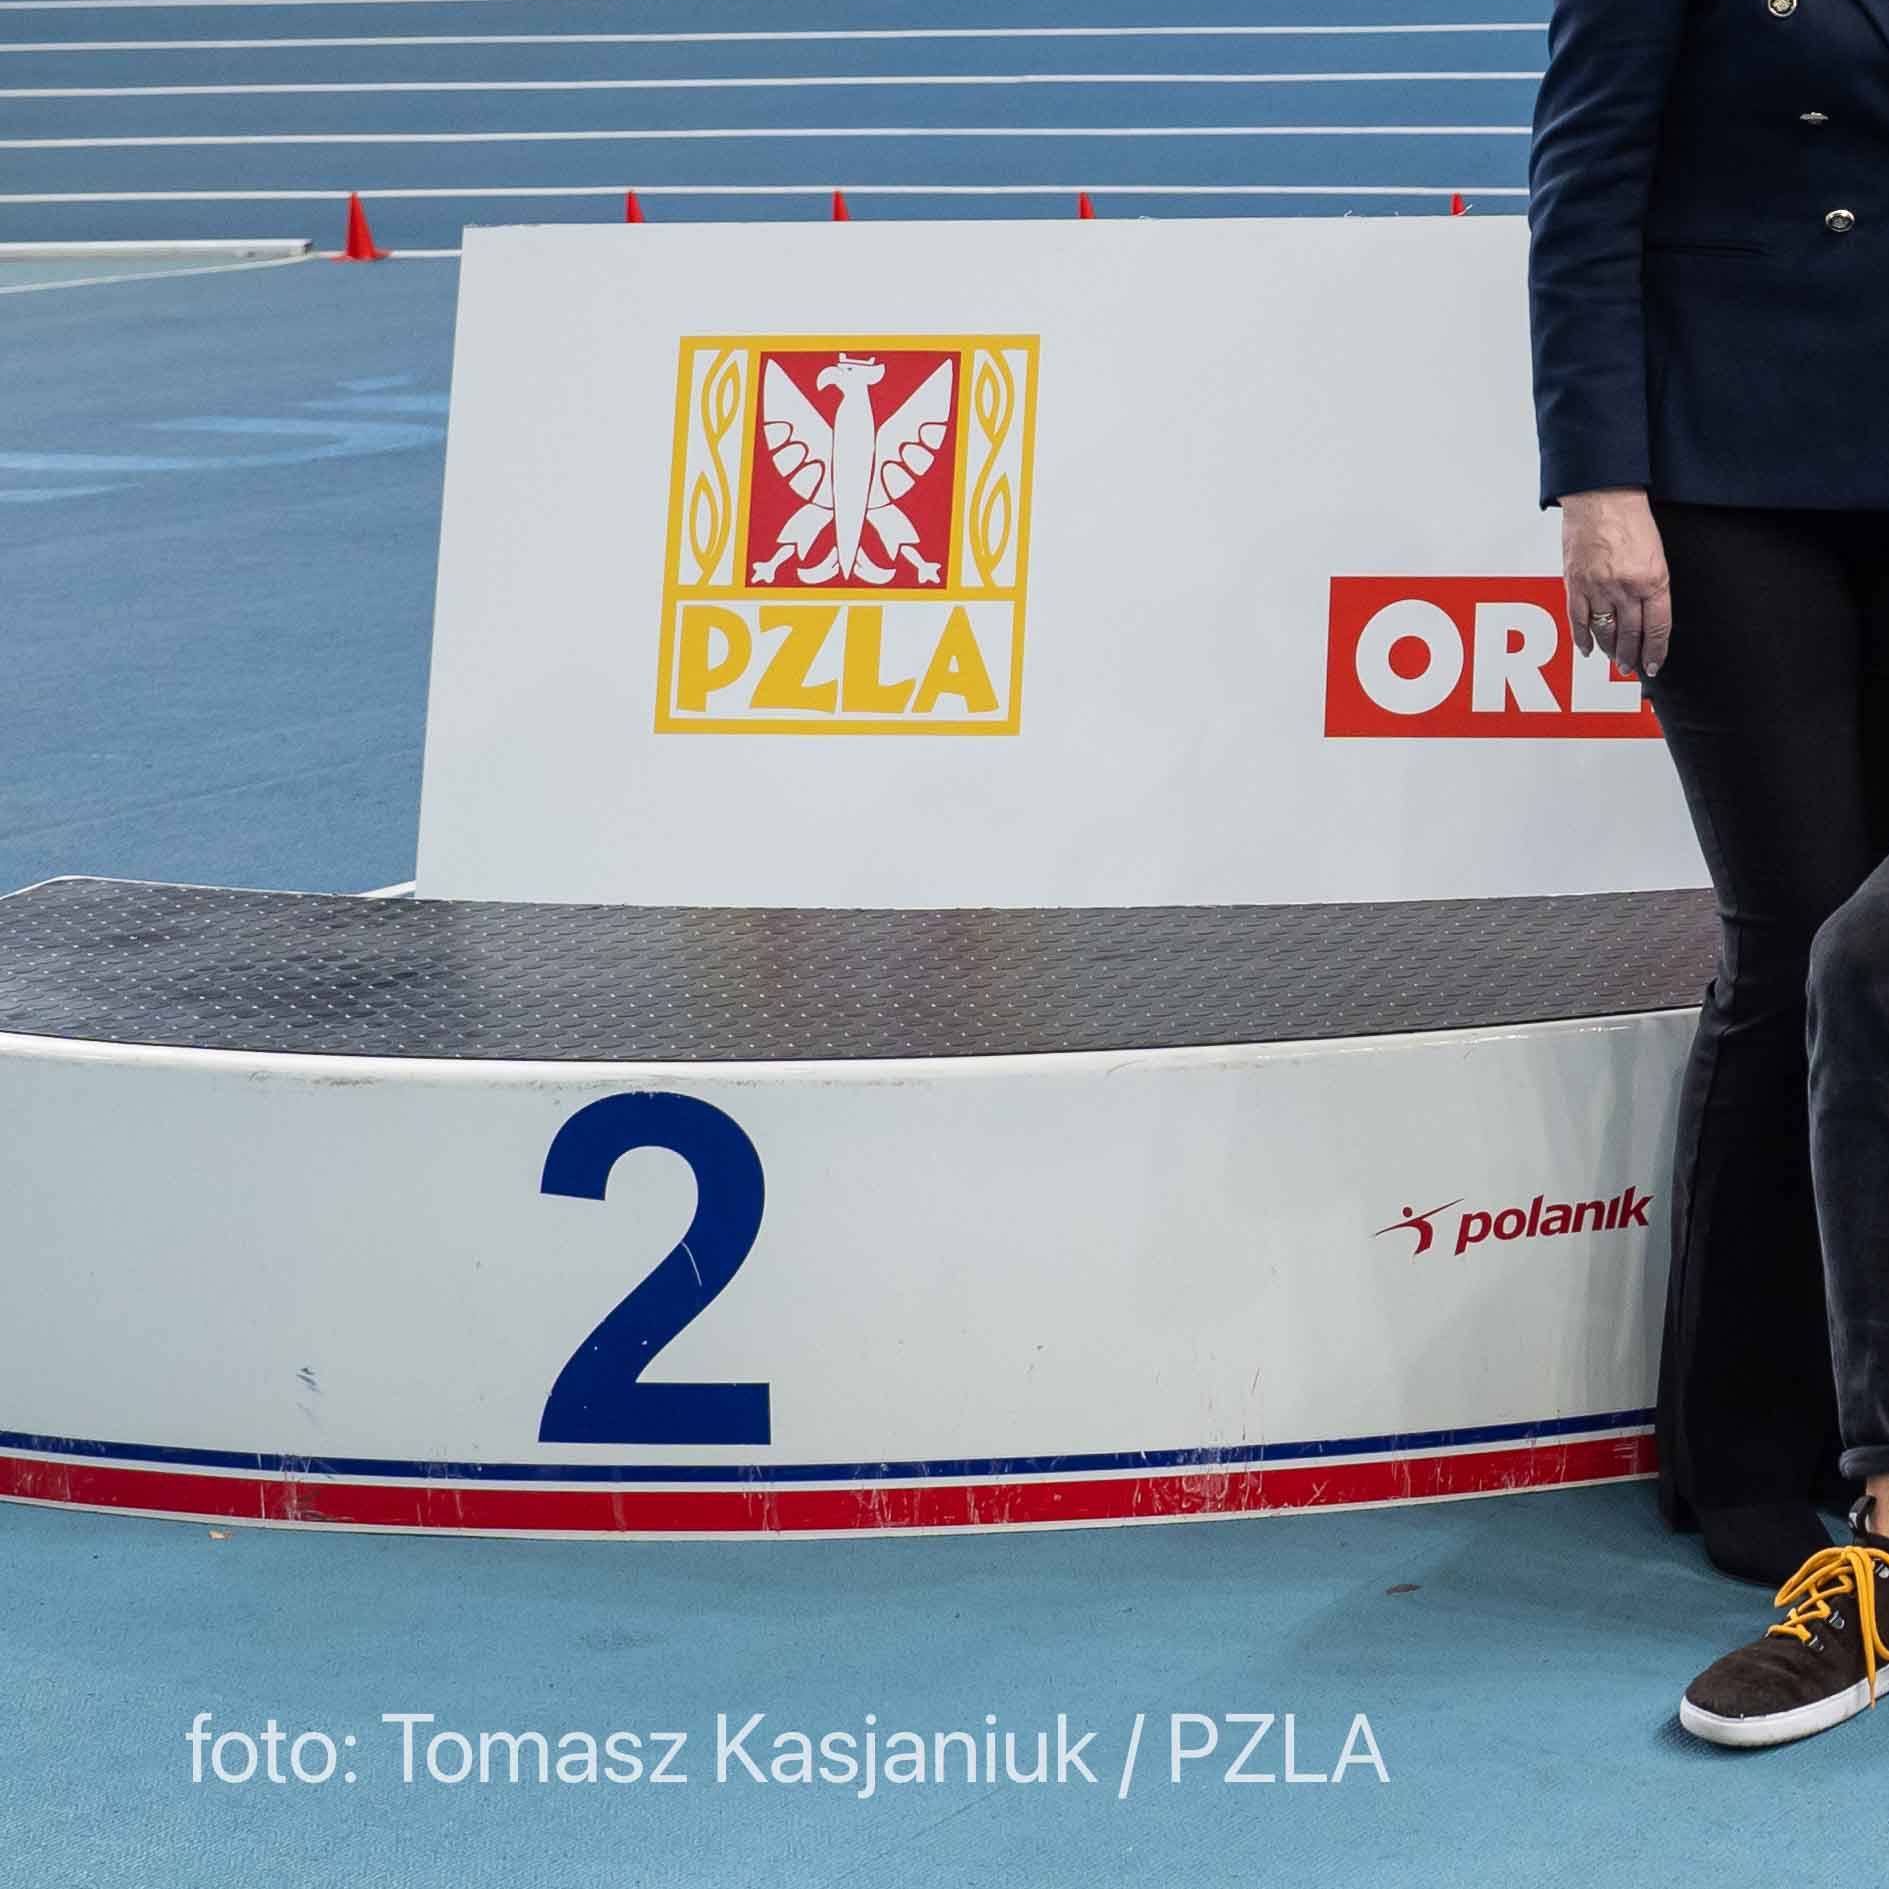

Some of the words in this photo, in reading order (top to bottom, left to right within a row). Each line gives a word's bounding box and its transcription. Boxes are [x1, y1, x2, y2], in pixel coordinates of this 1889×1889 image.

[676, 605, 1001, 714] PZLA
[1355, 599, 1646, 714] ORL
[538, 1092, 772, 1445] 2
